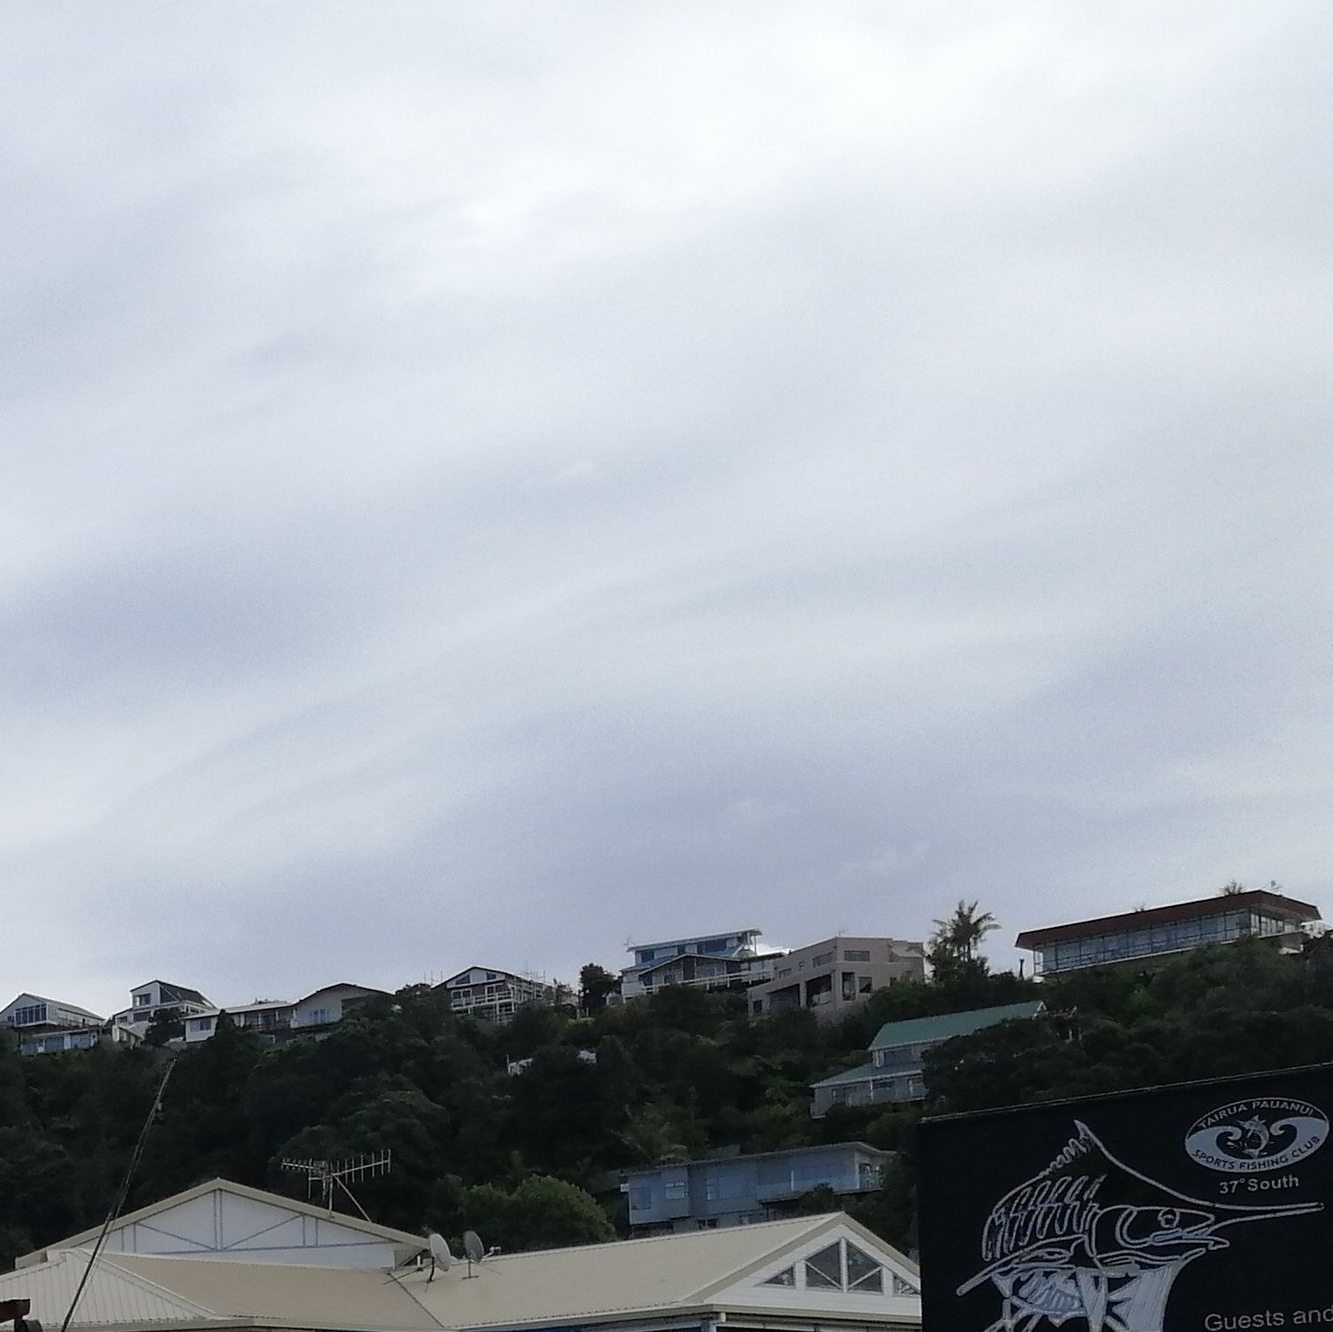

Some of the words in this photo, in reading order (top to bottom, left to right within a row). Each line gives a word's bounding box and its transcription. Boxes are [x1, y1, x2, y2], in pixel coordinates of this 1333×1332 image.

[1196, 1103, 1249, 1129] TAIRUA
[1252, 1100, 1316, 1116] PAUANUI
[1192, 1149, 1235, 1170] SPORTS
[1239, 1155, 1289, 1170] FISHING
[1292, 1136, 1320, 1158] CLUB
[1204, 1309, 1285, 1332] Guests
